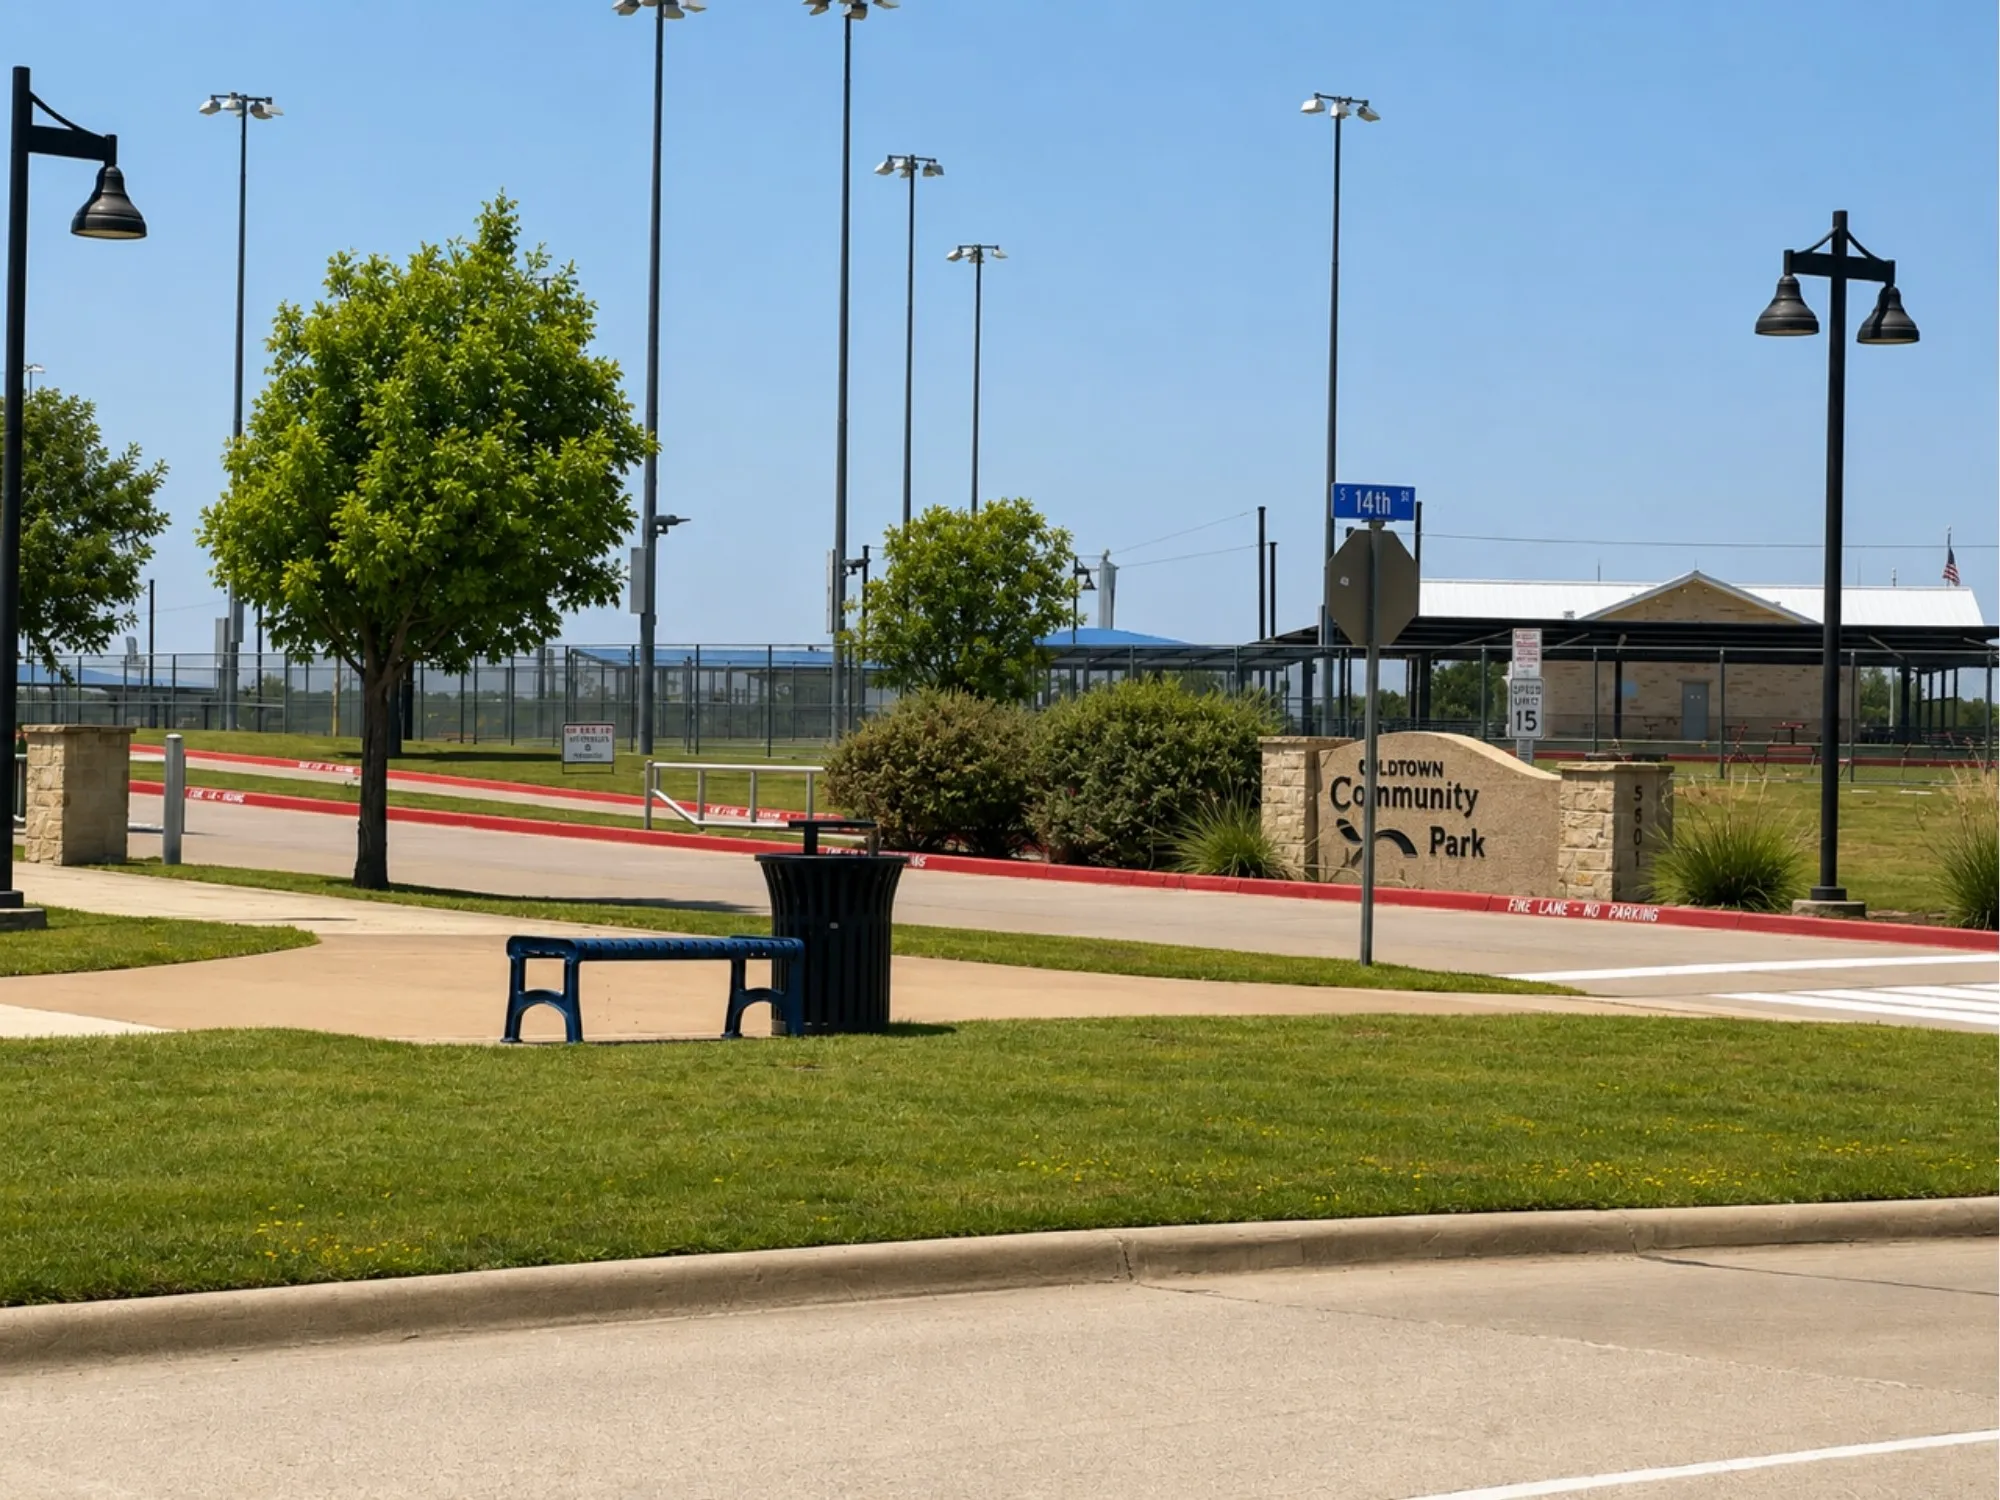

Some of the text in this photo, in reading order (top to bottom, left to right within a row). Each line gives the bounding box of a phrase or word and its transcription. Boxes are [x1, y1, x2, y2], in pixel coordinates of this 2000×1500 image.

[1340, 487, 1346, 501] S
[1355, 489, 1391, 515] 14th
[1516, 711, 1536, 731] 15
[1330, 776, 1479, 818] Community
[1633, 785, 1643, 867] 5601
[1429, 826, 1485, 857] Park
[1583, 904, 1600, 917] NO
[1608, 905, 1659, 921] PARKING
